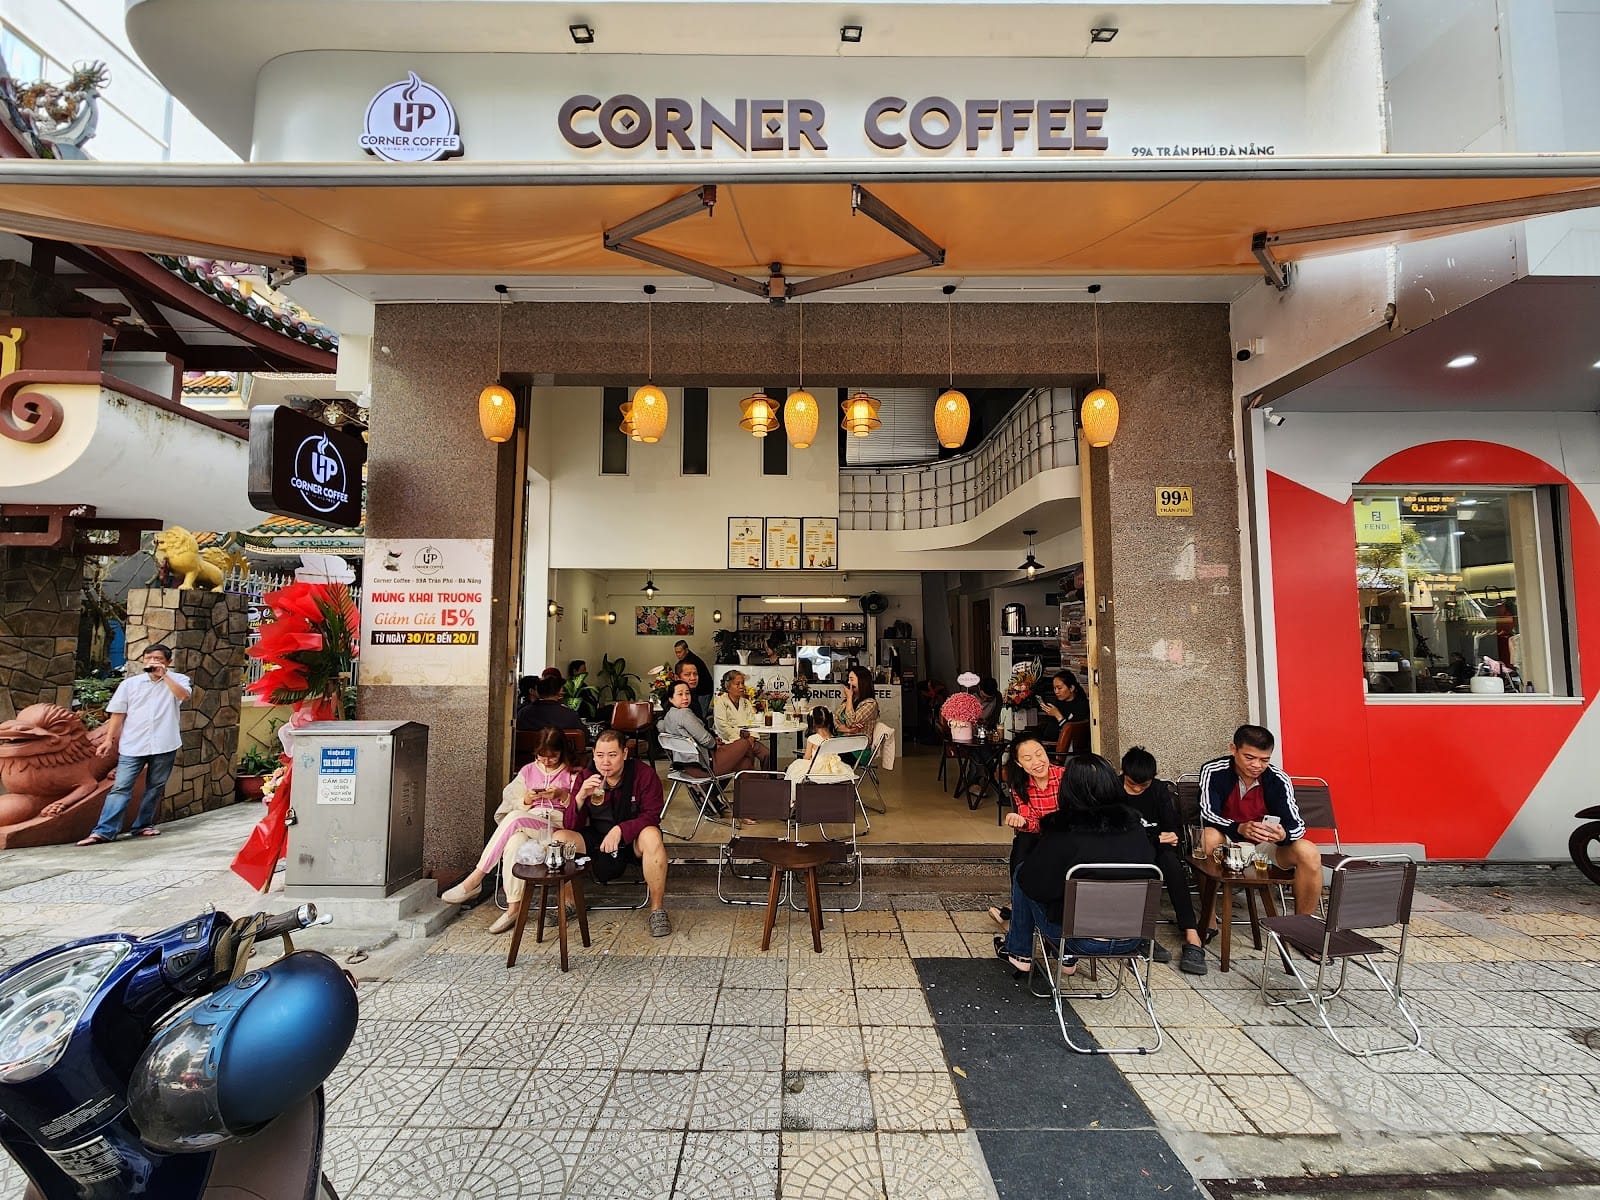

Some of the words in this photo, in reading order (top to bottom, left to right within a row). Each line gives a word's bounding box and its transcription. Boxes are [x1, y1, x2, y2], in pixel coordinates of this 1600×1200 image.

[557, 94, 828, 152] CORNER
[864, 96, 1109, 151] COFFEE
[360, 135, 410, 146] CORNER
[412, 136, 456, 147] COFFEE
[1131, 147, 1153, 157] 99A
[290, 477, 323, 495] CORNER
[323, 487, 349, 503] COFFEE
[408, 592, 434, 603] KHAI
[413, 612, 437, 625] Giá
[440, 608, 475, 626] 15%
[386, 632, 406, 643] NGÀY
[406, 632, 436, 644] 30/12
[436, 632, 452, 643] ĐẾN
[452, 632, 476, 644] 20/1
